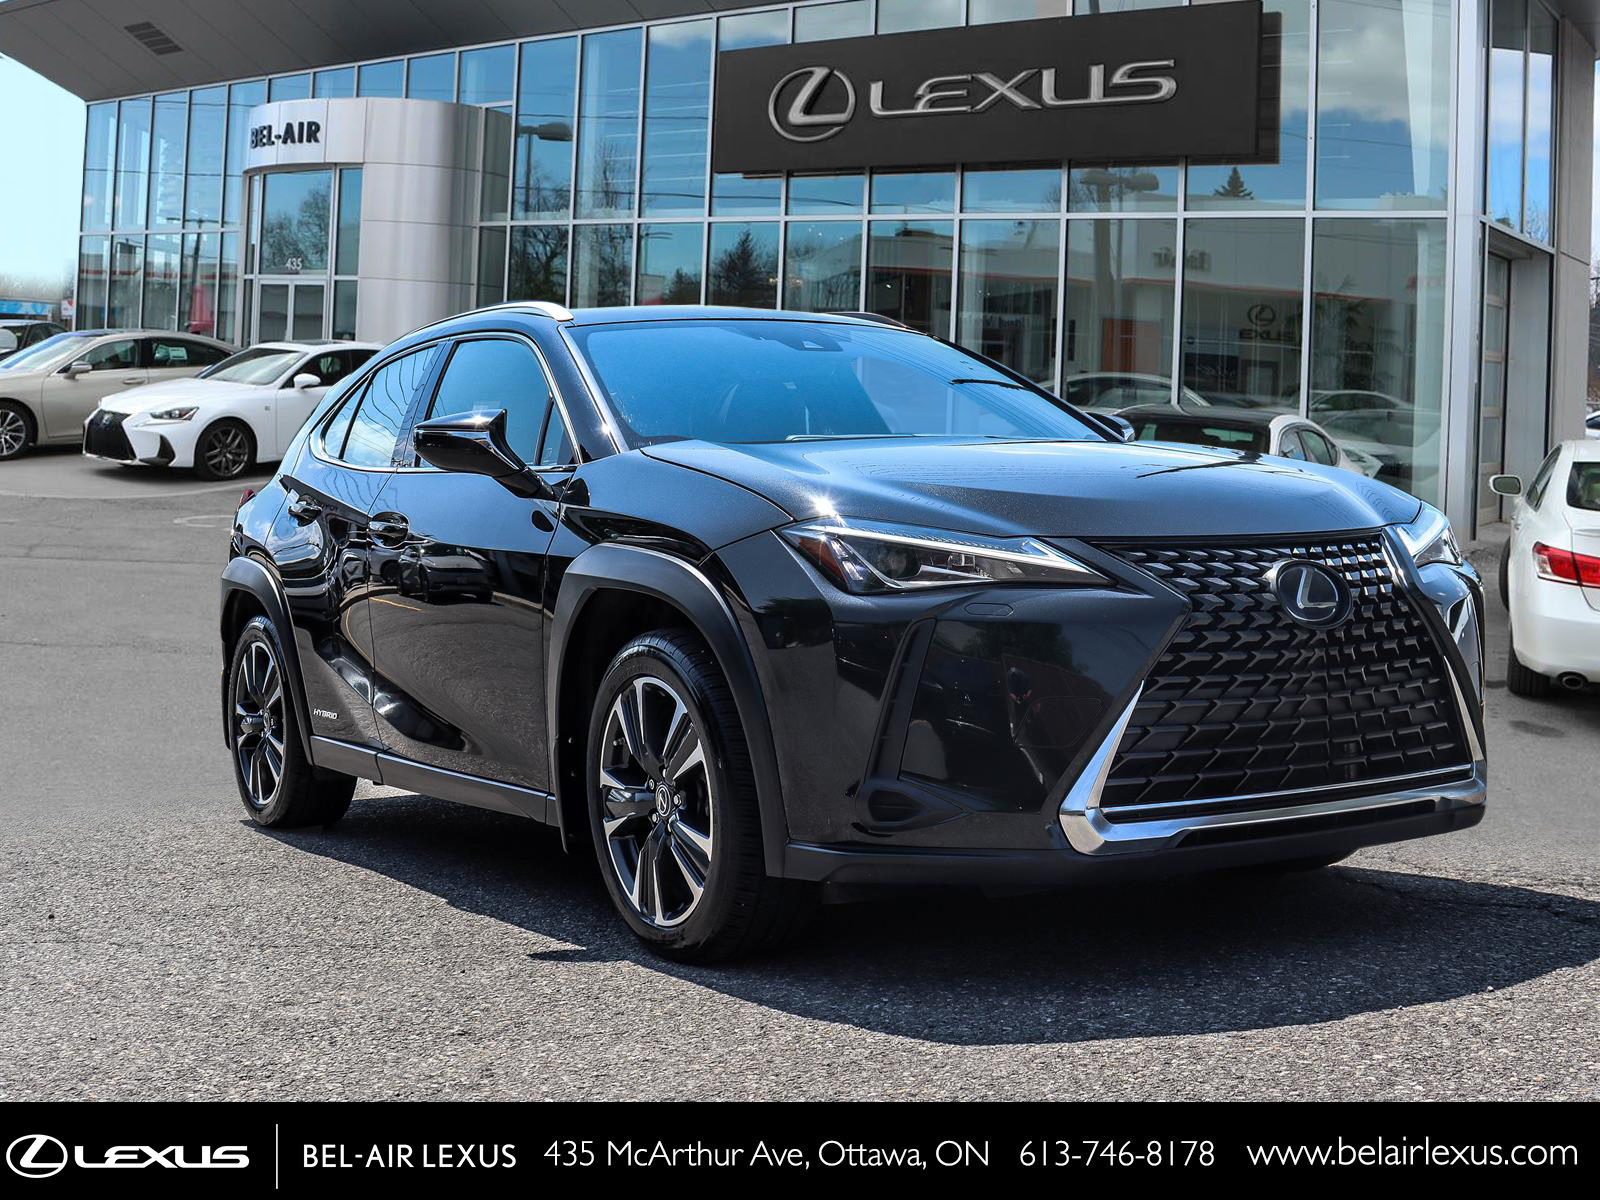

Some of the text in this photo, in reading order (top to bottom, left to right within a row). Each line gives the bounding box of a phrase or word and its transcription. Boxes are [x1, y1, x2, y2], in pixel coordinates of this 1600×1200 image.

[869, 59, 1177, 118] LEXUS
[250, 120, 321, 149] BEL-AIR
[285, 257, 303, 270] 435
[313, 708, 338, 720] HYBRID
